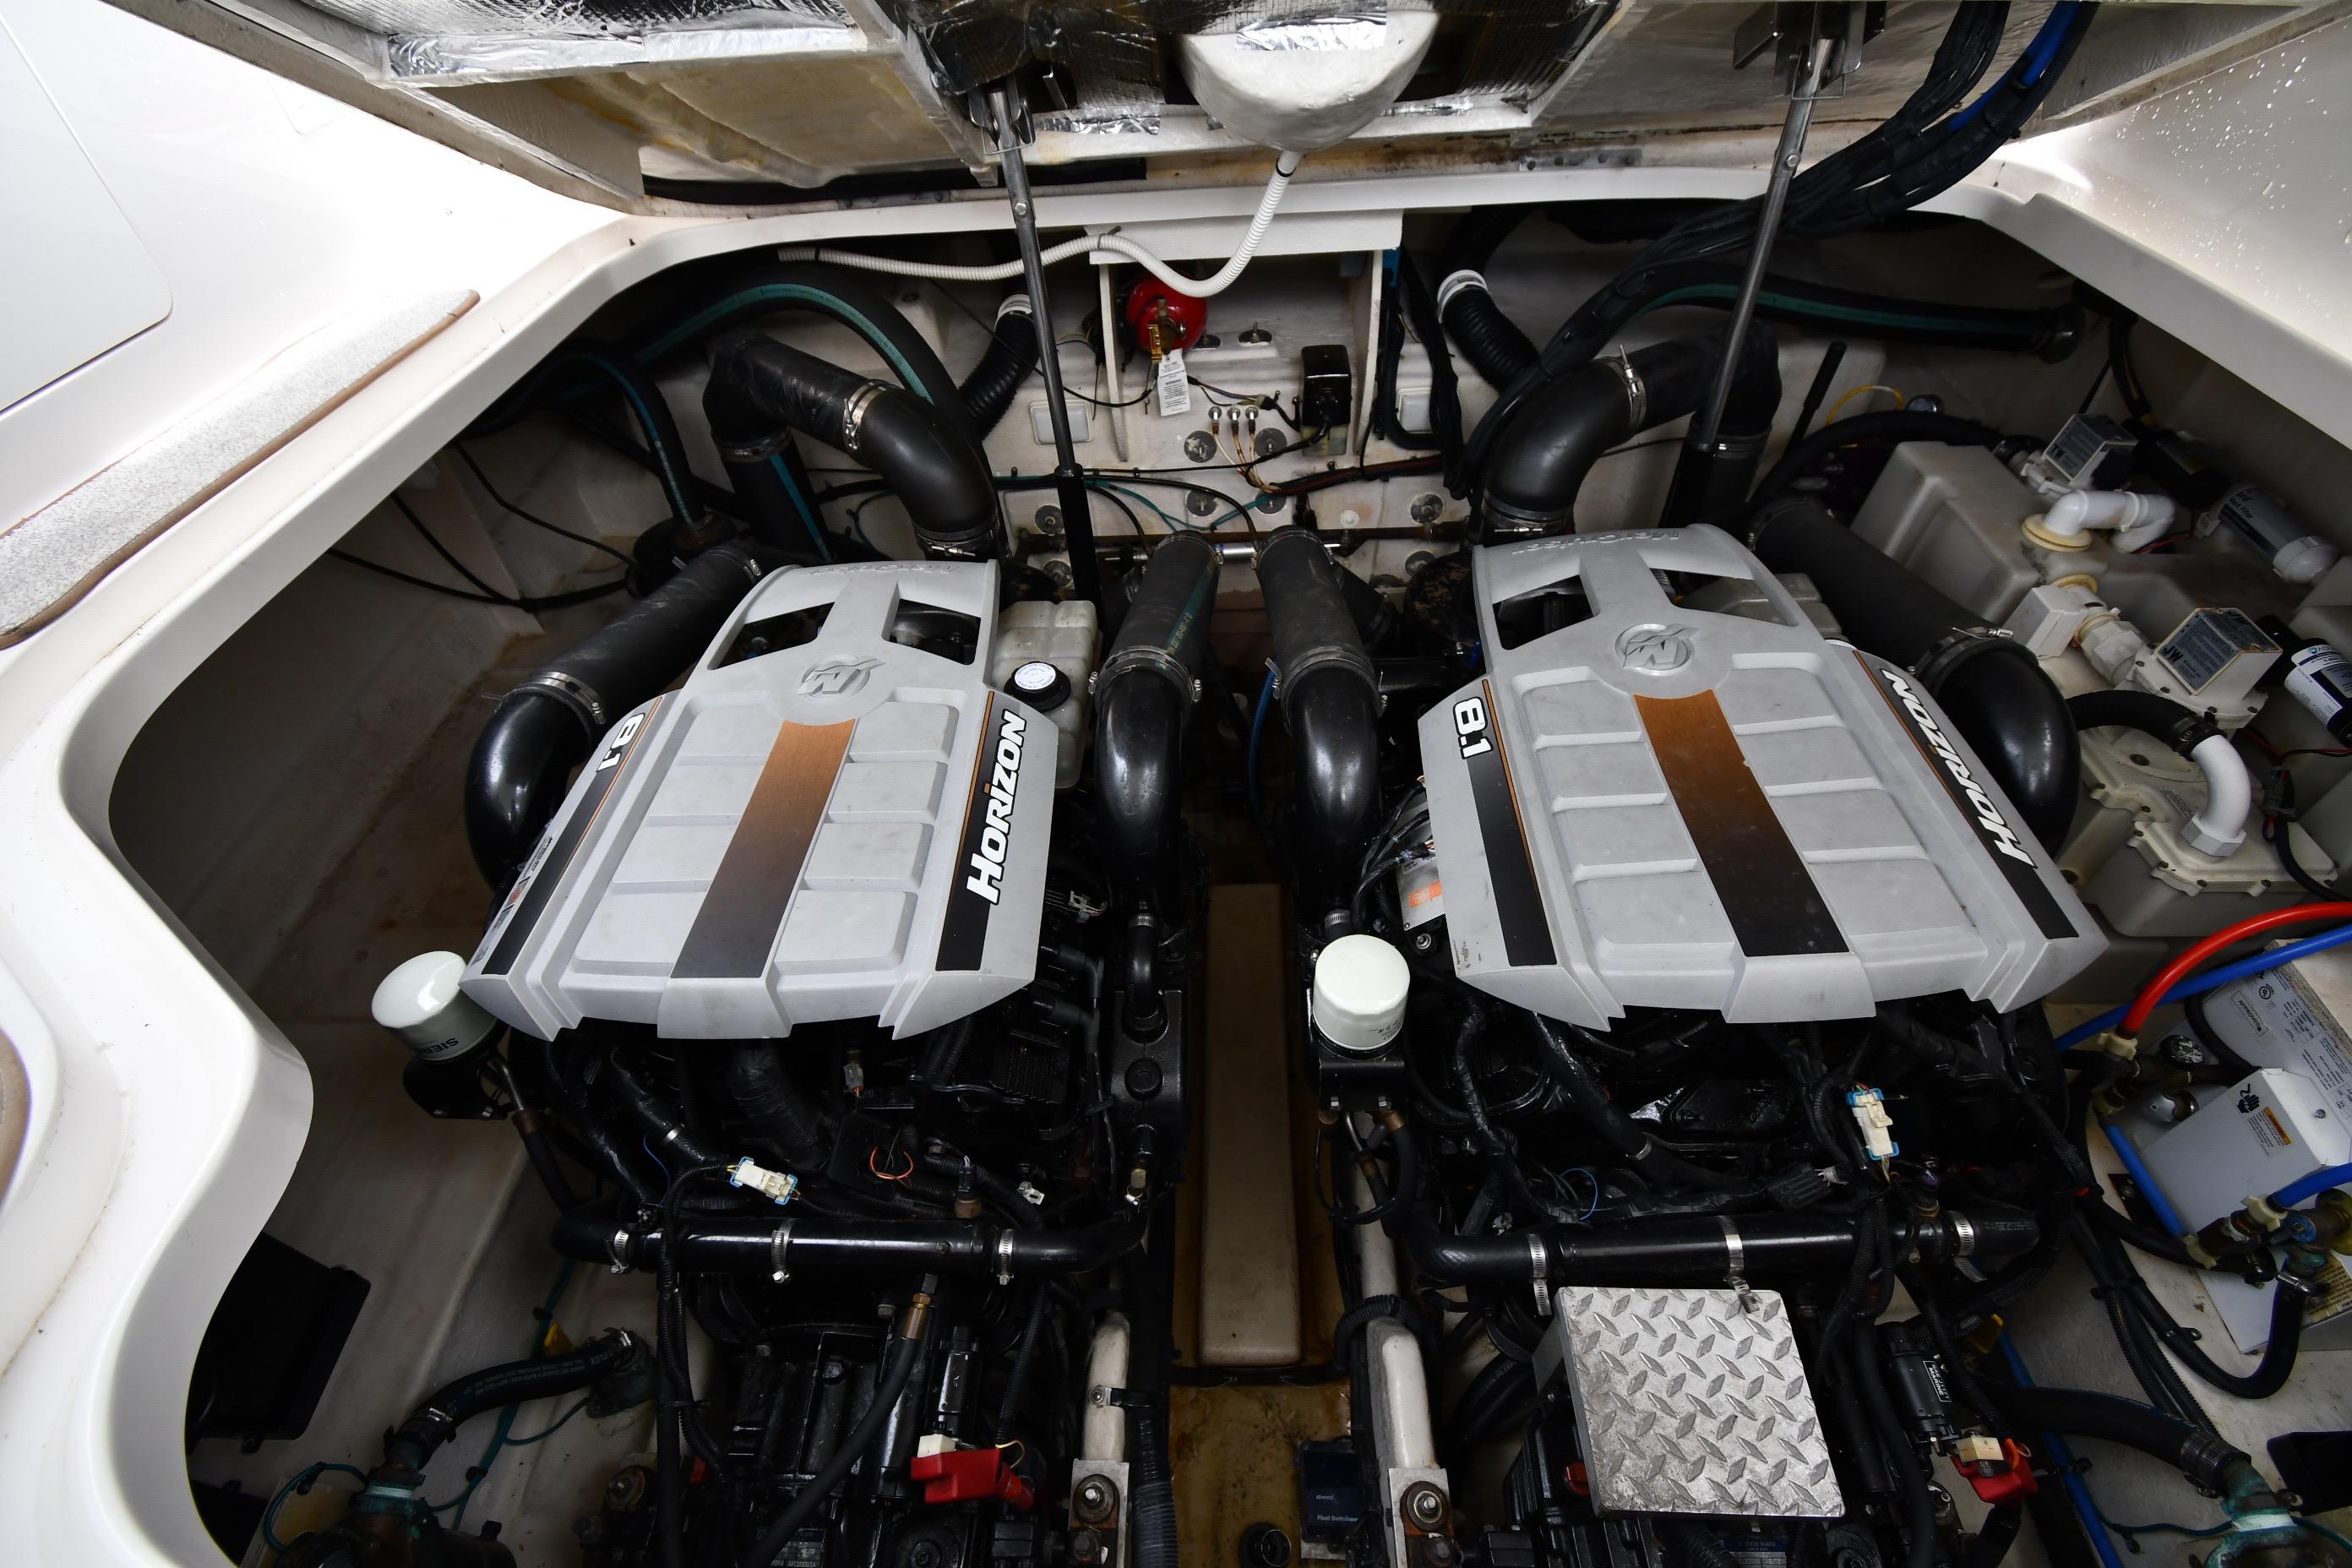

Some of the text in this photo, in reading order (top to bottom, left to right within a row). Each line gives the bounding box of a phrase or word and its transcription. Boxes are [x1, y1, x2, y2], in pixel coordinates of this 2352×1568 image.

[596, 713, 645, 772] 8.1
[1453, 696, 1494, 760] 8.1
[2239, 1000, 2260, 1027] APPROVED
[1928, 1367, 1945, 1395] MARINE
